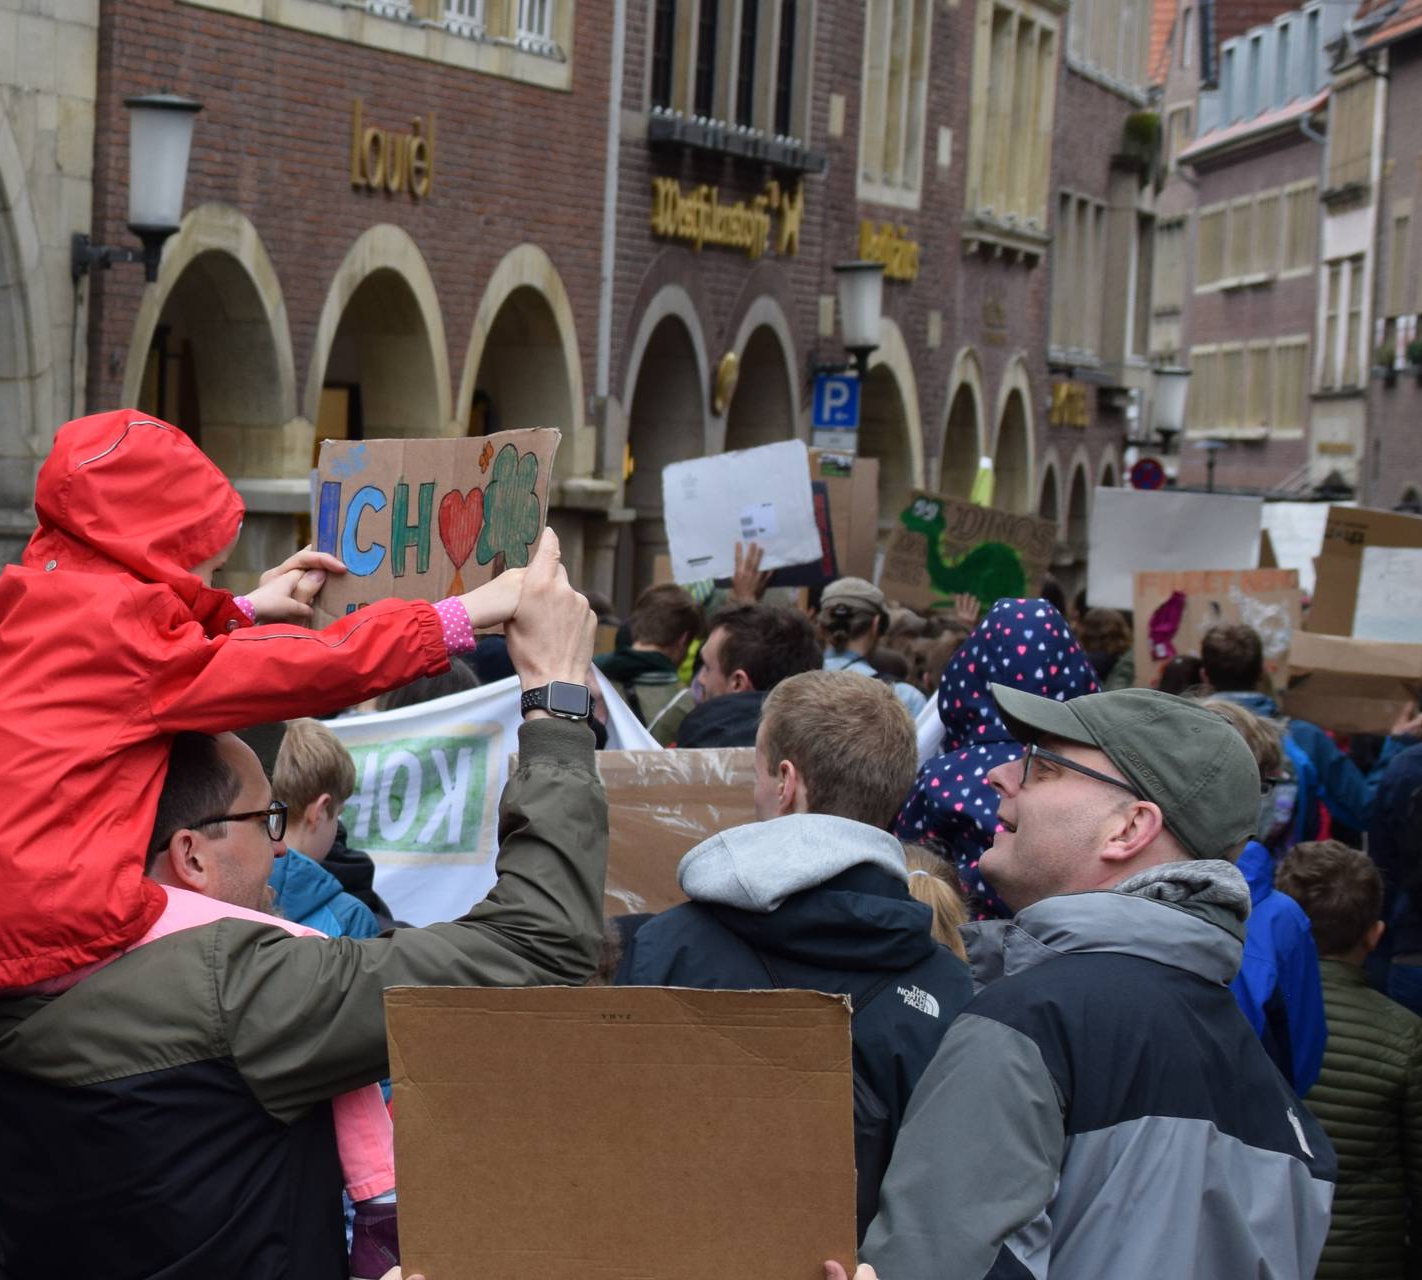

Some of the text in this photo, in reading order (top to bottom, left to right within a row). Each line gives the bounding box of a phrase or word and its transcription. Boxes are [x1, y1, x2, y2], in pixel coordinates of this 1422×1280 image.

[822, 380, 850, 423] P
[318, 477, 436, 577] ICH
[897, 986, 926, 1004] NORTH
[911, 984, 928, 998] THE
[904, 995, 925, 1012] FACE
